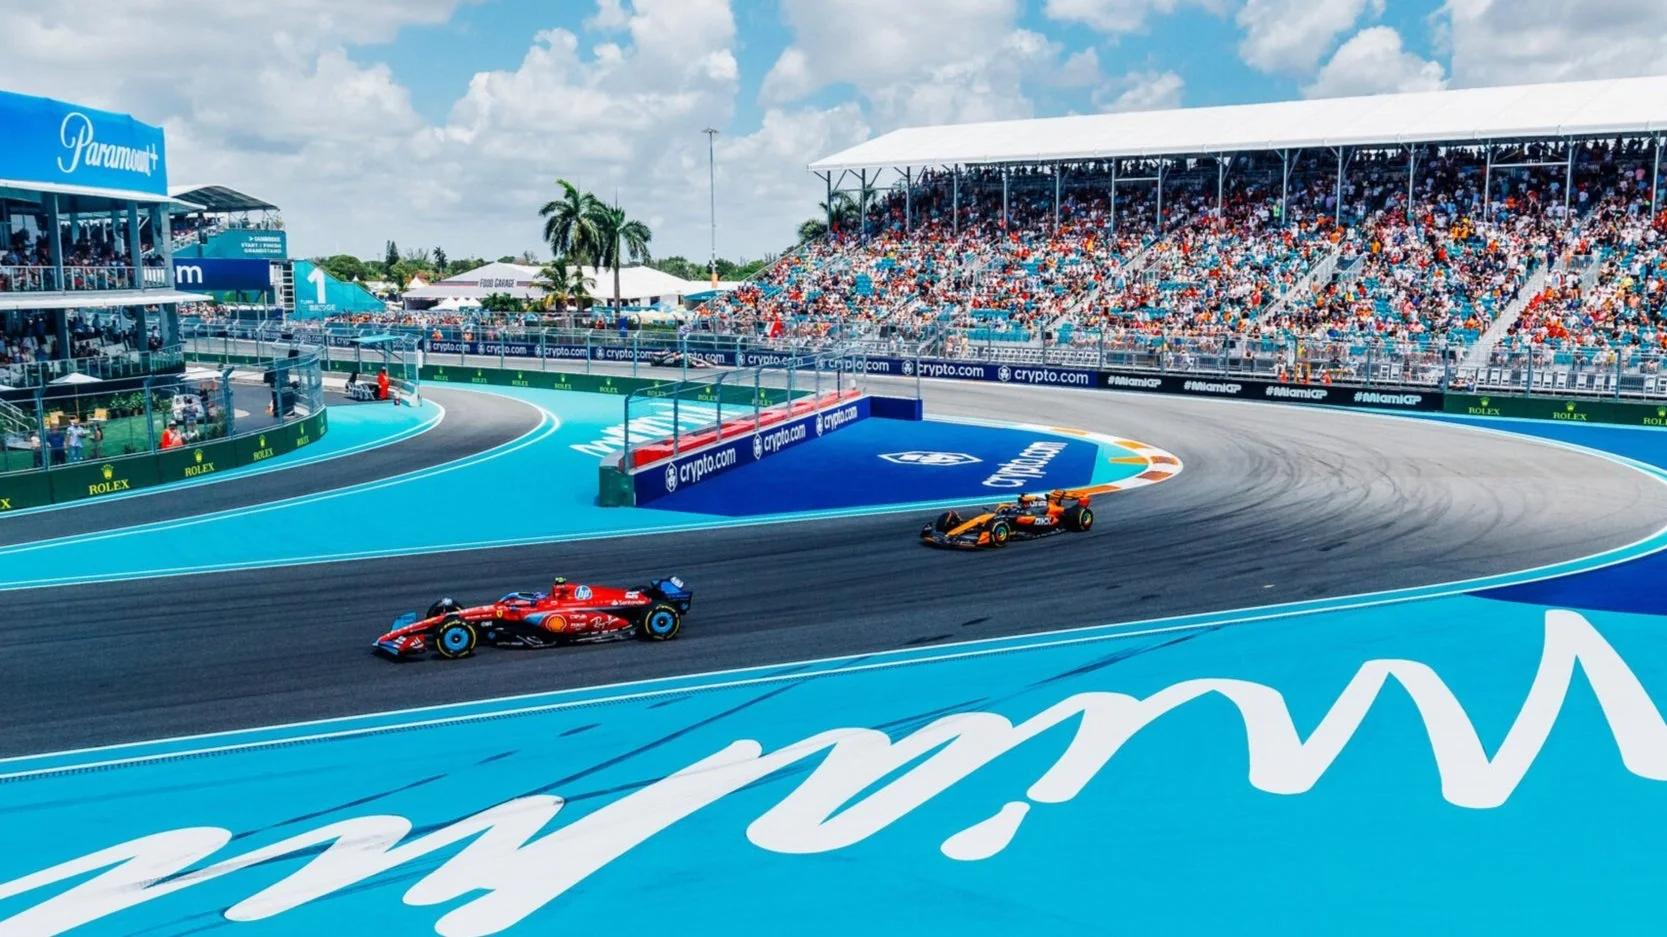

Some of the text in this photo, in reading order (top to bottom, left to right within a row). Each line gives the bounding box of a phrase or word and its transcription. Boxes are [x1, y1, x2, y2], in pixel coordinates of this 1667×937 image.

[57, 112, 159, 177] Paramount+
[307, 267, 327, 304] 1
[480, 278, 515, 288] FOOD GARAGE
[918, 362, 985, 378] crypto.com
[1014, 370, 1089, 385] crypto.com
[1107, 375, 1162, 388] #MiamiGP
[1183, 381, 1242, 393] #MiamiGP
[1265, 386, 1328, 399] #MiamiGP
[1354, 391, 1422, 406] #MiamiGP
[824, 405, 858, 431] crypto.com
[1468, 406, 1501, 416] ROLEX
[1553, 412, 1588, 421] ROLEX
[1643, 417, 1667, 426] ROL
[764, 423, 806, 452] crypto.com
[253, 447, 274, 461] ROLEX
[184, 462, 215, 477] ROLEX
[680, 446, 736, 483] crypto.com
[88, 479, 130, 495] ROLEX
[577, 585, 590, 600] hp
